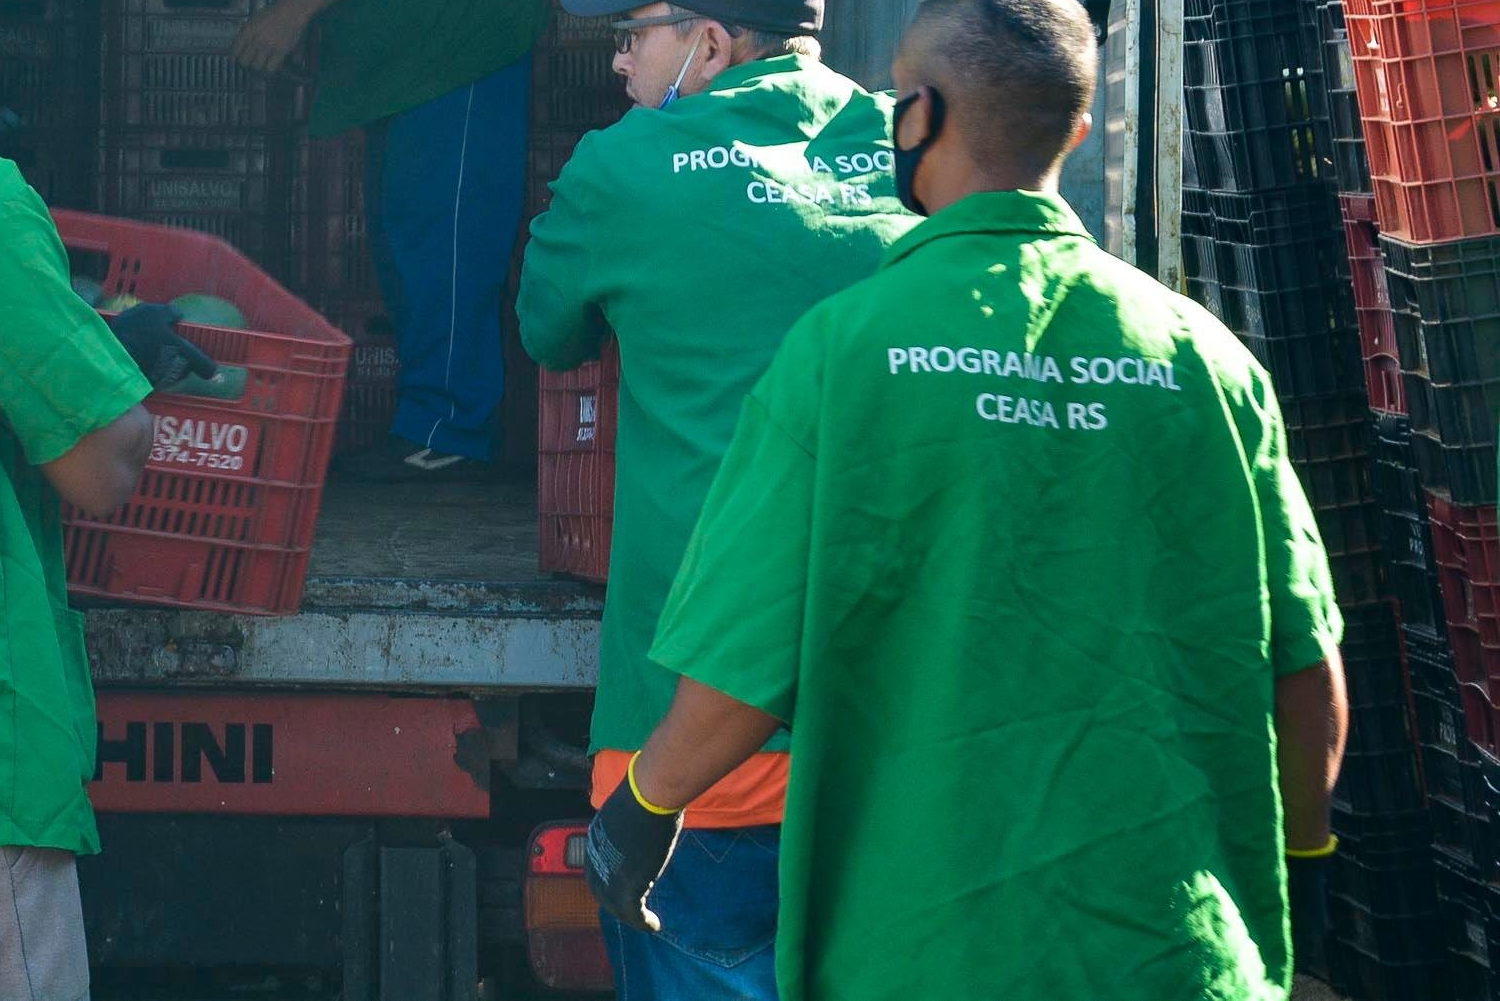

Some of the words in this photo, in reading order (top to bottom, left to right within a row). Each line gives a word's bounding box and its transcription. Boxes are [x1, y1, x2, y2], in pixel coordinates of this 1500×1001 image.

[151, 180, 232, 197] UNISALVO
[746, 181, 835, 204] CEASA
[841, 183, 873, 206] RS
[1070, 356, 1181, 391] SOCIAL
[975, 393, 1060, 429] CEASA
[1067, 402, 1108, 431] RS
